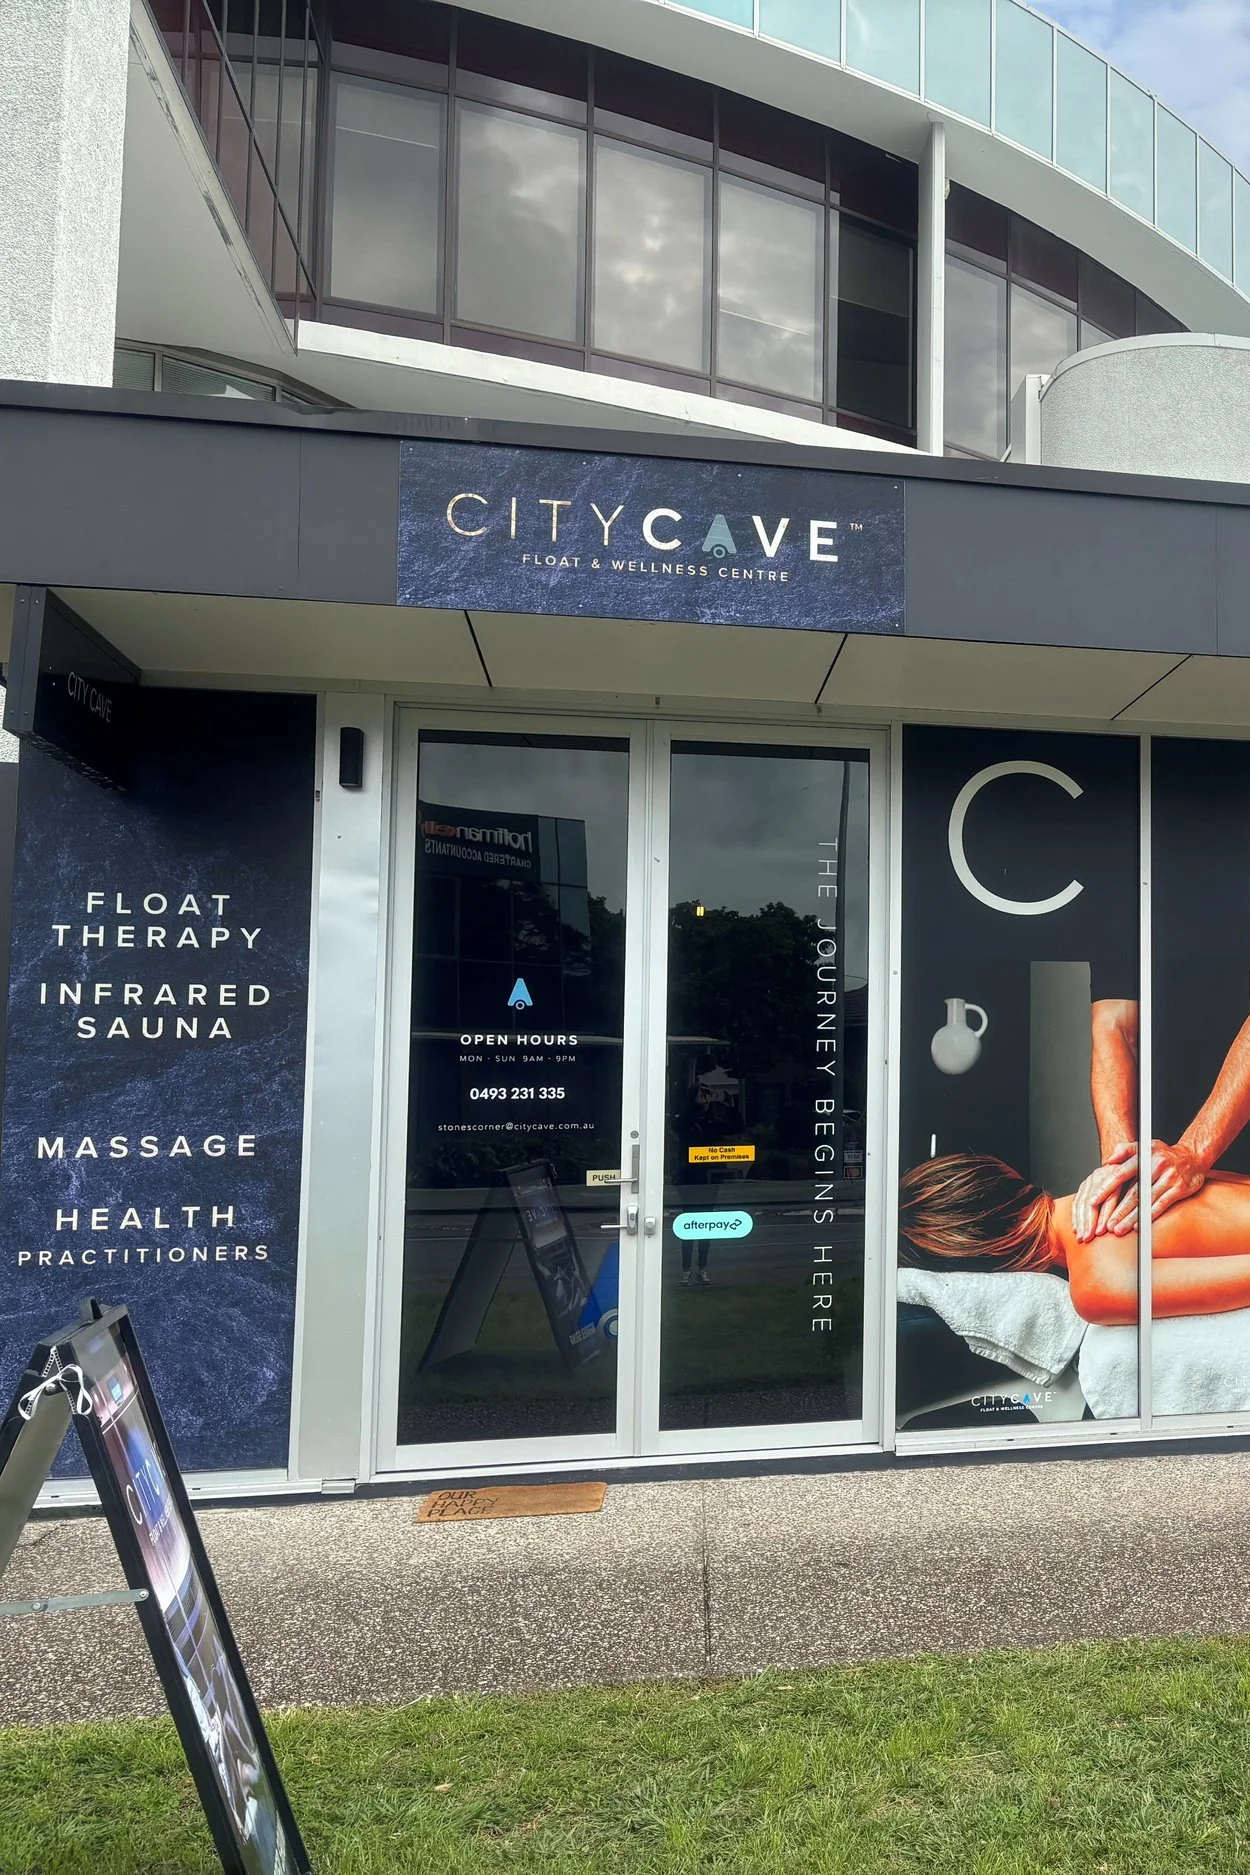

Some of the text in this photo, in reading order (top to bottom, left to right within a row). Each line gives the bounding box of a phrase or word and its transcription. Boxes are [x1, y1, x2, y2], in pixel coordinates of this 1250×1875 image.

[522, 554, 789, 582] FLOAT & WELLNESS CENTRE
[67, 671, 112, 722] CITY CAVE
[86, 892, 231, 916] FLOAT
[51, 925, 262, 949] THERAPY
[39, 982, 271, 1006] INFRARED
[76, 1016, 232, 1039] SAUNA
[460, 1034, 578, 1046] OPEN HOURS
[469, 1087, 566, 1100] 0493 231 335
[811, 838, 838, 1333] THE JOURNEY BEGINS HERE
[437, 1122, 595, 1132] stonescorner@citycave.com.au
[37, 1134, 256, 1159] MASSAGE
[592, 1174, 616, 1182] PUSH
[55, 1205, 235, 1231] HEALTH
[683, 1219, 730, 1231] afterpay
[18, 1245, 269, 1266] PRACTITIONERS
[431, 1497, 500, 1509] HAPPY
[438, 1491, 477, 1500] OUR
[426, 1505, 495, 1517] PLACE
